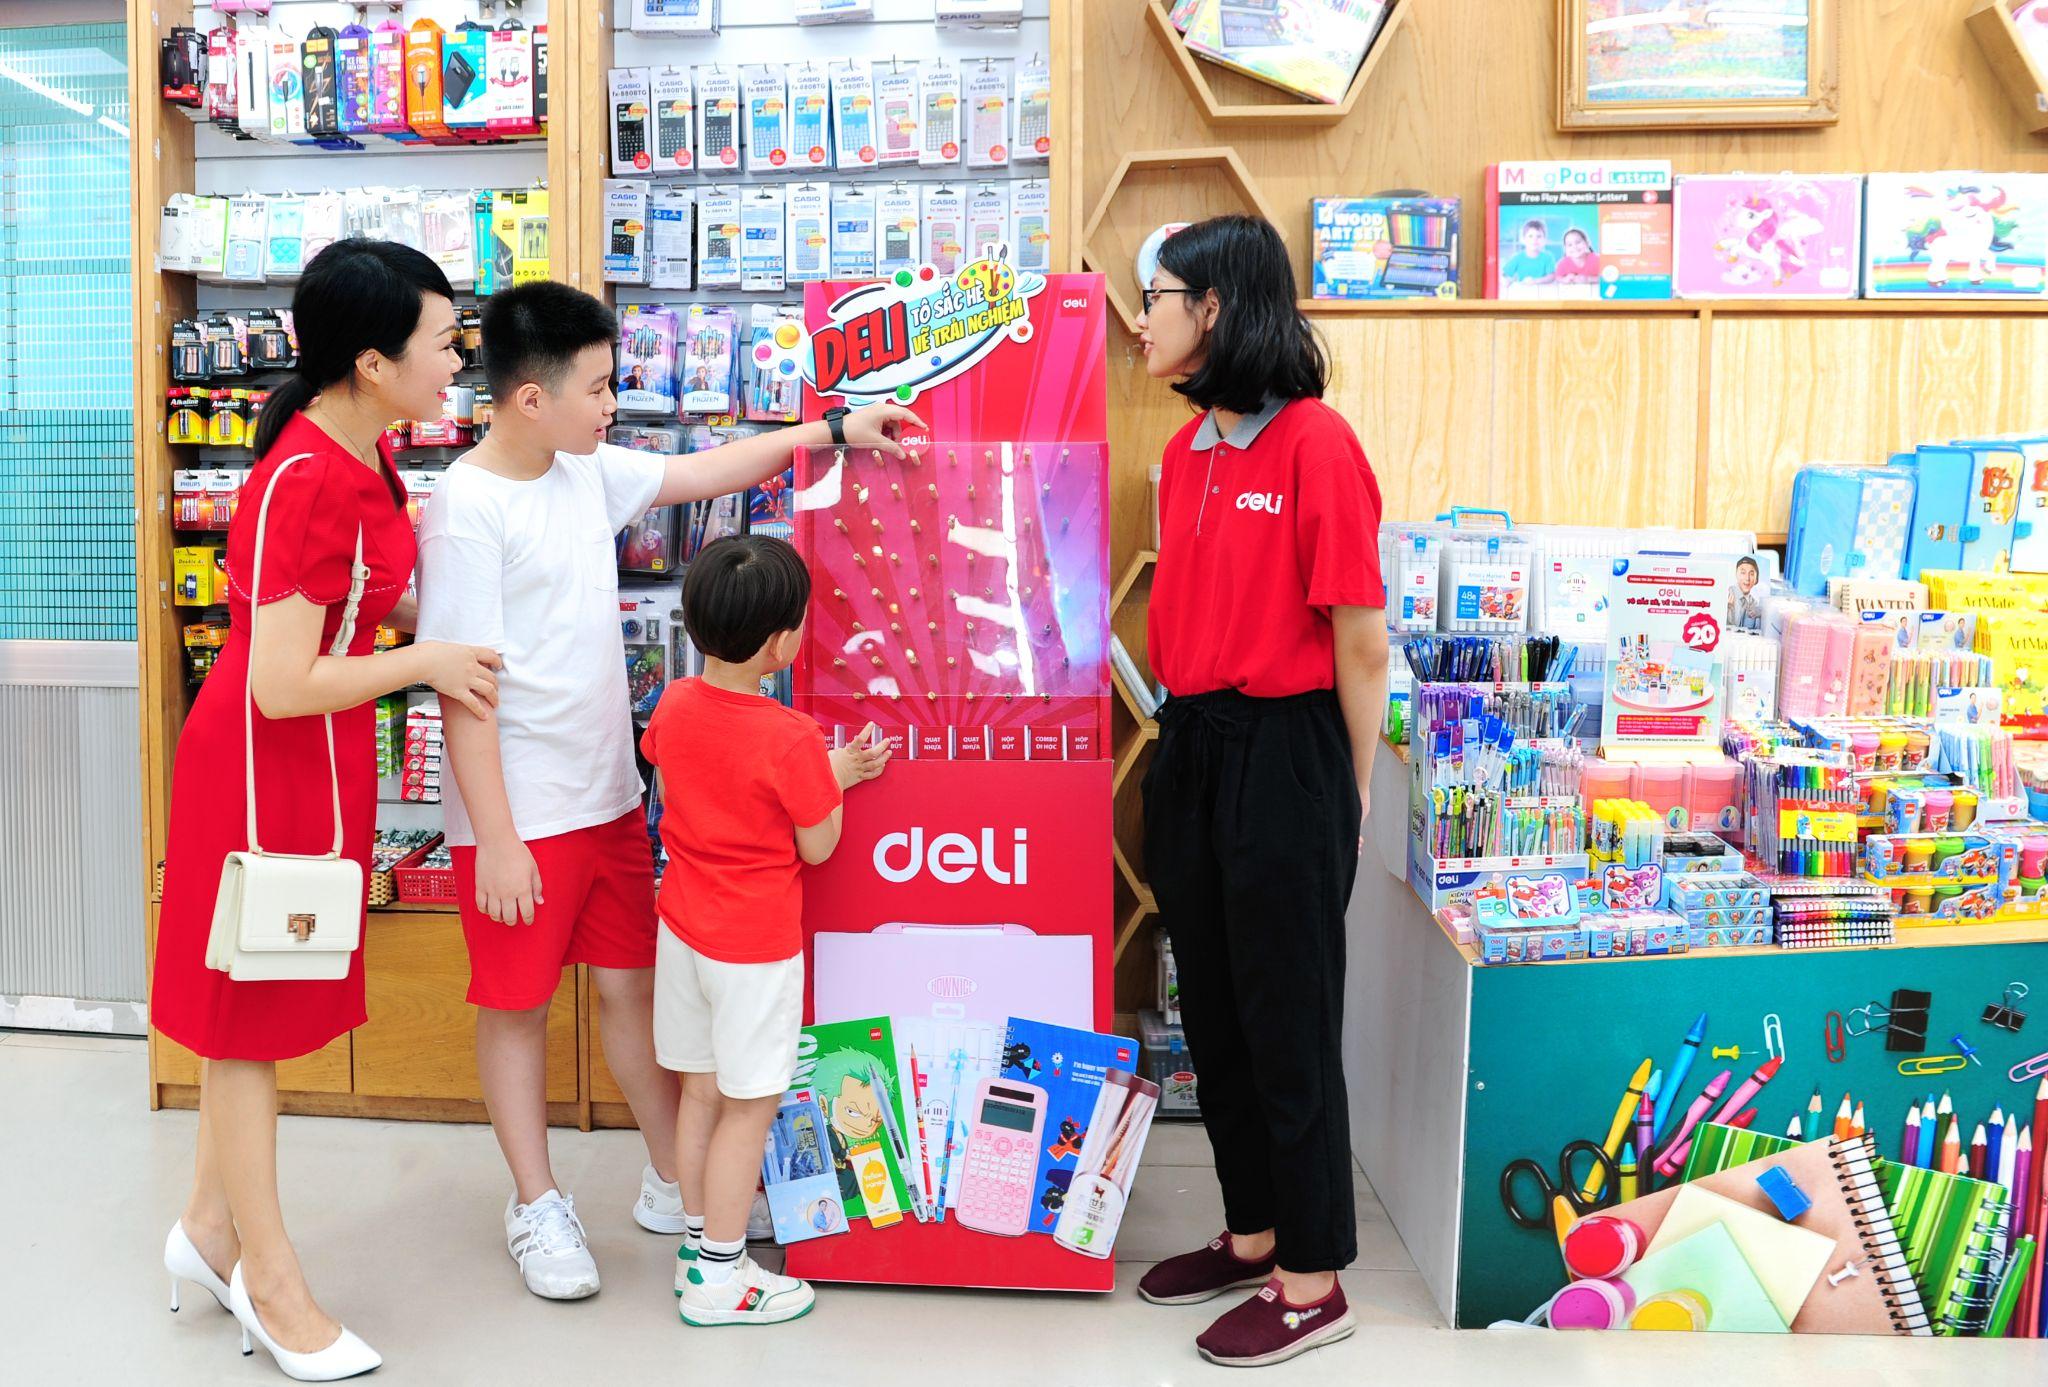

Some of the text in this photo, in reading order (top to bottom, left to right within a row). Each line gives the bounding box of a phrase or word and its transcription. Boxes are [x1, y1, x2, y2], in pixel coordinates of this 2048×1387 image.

[1505, 167, 1602, 188] MgPad
[1521, 193, 1540, 202] Free
[1559, 193, 1596, 203] Magnetic
[1597, 192, 1628, 202] Letters
[1334, 213, 1383, 226] WOOD
[1320, 226, 1384, 240] ART SET
[910, 297, 932, 328] TÔ
[933, 281, 964, 319] SẮC
[1063, 298, 1087, 308] deli
[912, 296, 1025, 356] VẼ TRẢI NGHIỆM
[811, 300, 910, 393] DELI
[170, 398, 199, 406] Alkaline
[211, 400, 241, 408] Alkaline
[692, 395, 719, 403] FROZEN
[902, 435, 927, 446] deli
[1235, 491, 1283, 515] deli
[1658, 588, 1681, 597] deli
[1855, 599, 1915, 612] WANTED
[2008, 636, 2048, 650] ArtMa
[925, 736, 941, 744] QUẠT
[963, 736, 980, 744] QUẠT
[1001, 736, 1015, 744] HỘP
[962, 743, 980, 751] NHỰA
[1043, 743, 1057, 751] HỌC
[873, 827, 1027, 885] deli
[1438, 874, 1459, 884] deli
